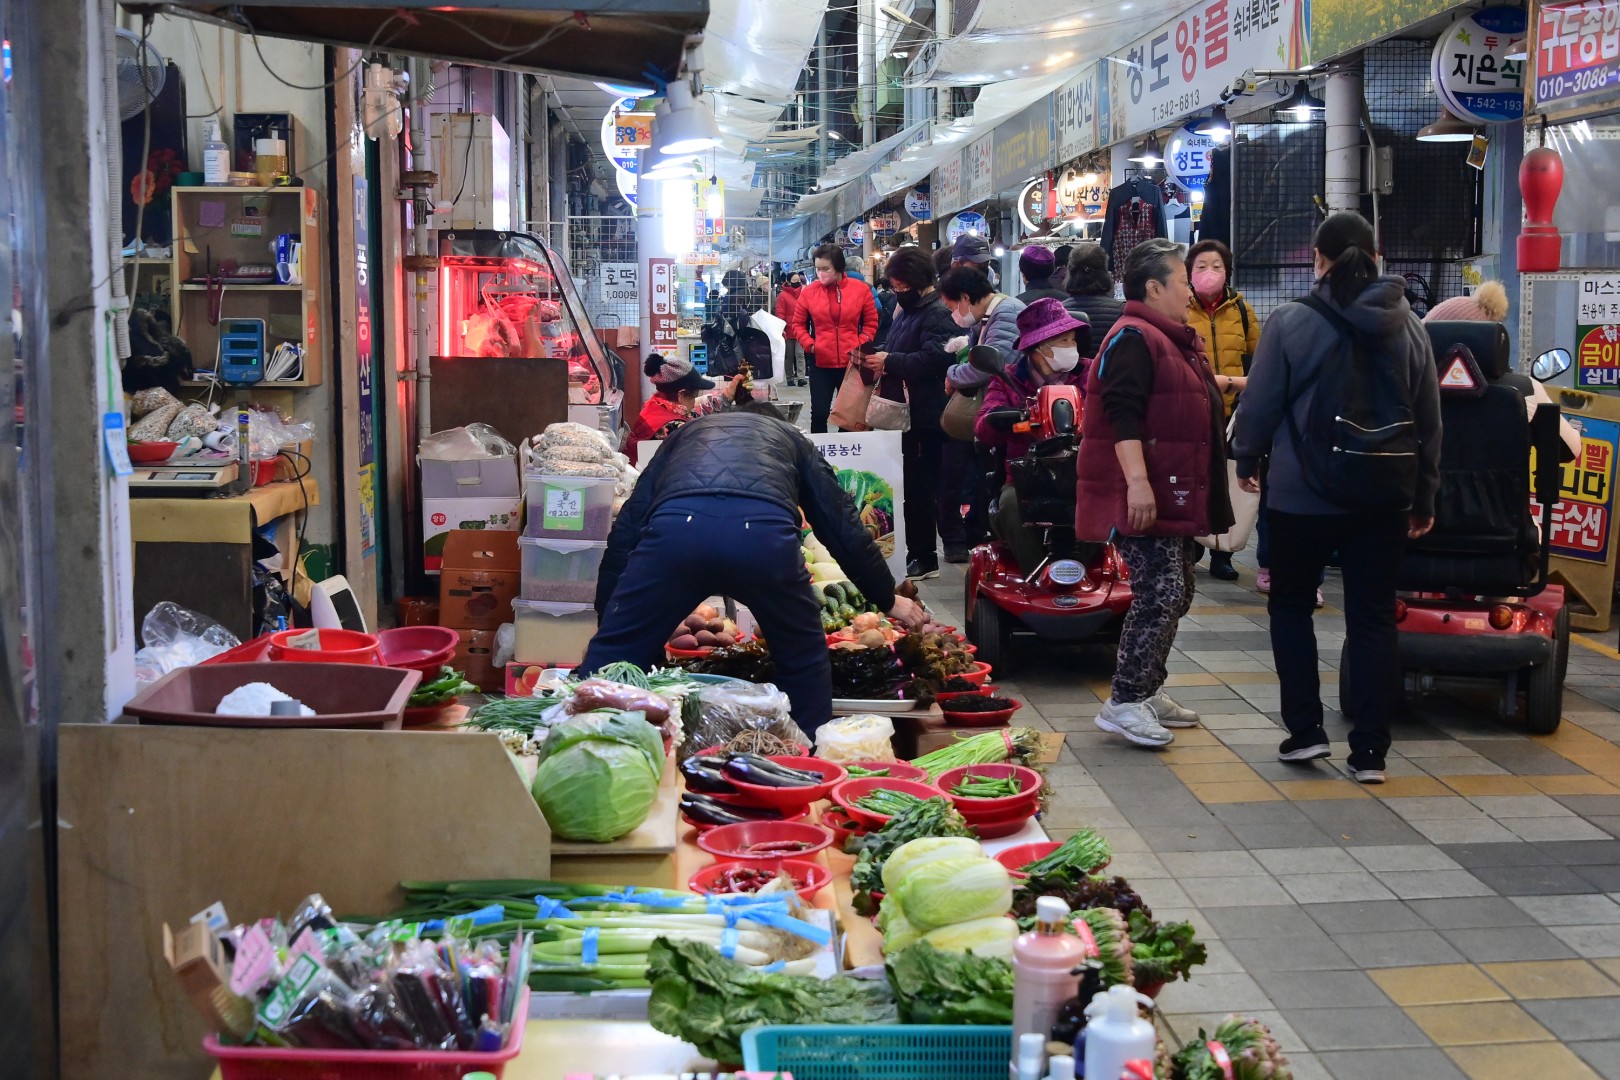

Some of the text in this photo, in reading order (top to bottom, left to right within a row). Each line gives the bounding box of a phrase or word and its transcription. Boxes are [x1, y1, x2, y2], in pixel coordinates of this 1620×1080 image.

[1539, 66, 1620, 100] 010-3088-
[1058, 76, 1093, 135] 미화생선
[1151, 90, 1200, 123] T.542-6813
[1187, 138, 1220, 148] 숙녀복전
[1175, 150, 1212, 172] 청도
[605, 267, 637, 288] 호떡
[656, 265, 667, 312] 추어탕
[606, 290, 638, 300] 1,000원
[1586, 368, 1620, 385] 삽니
